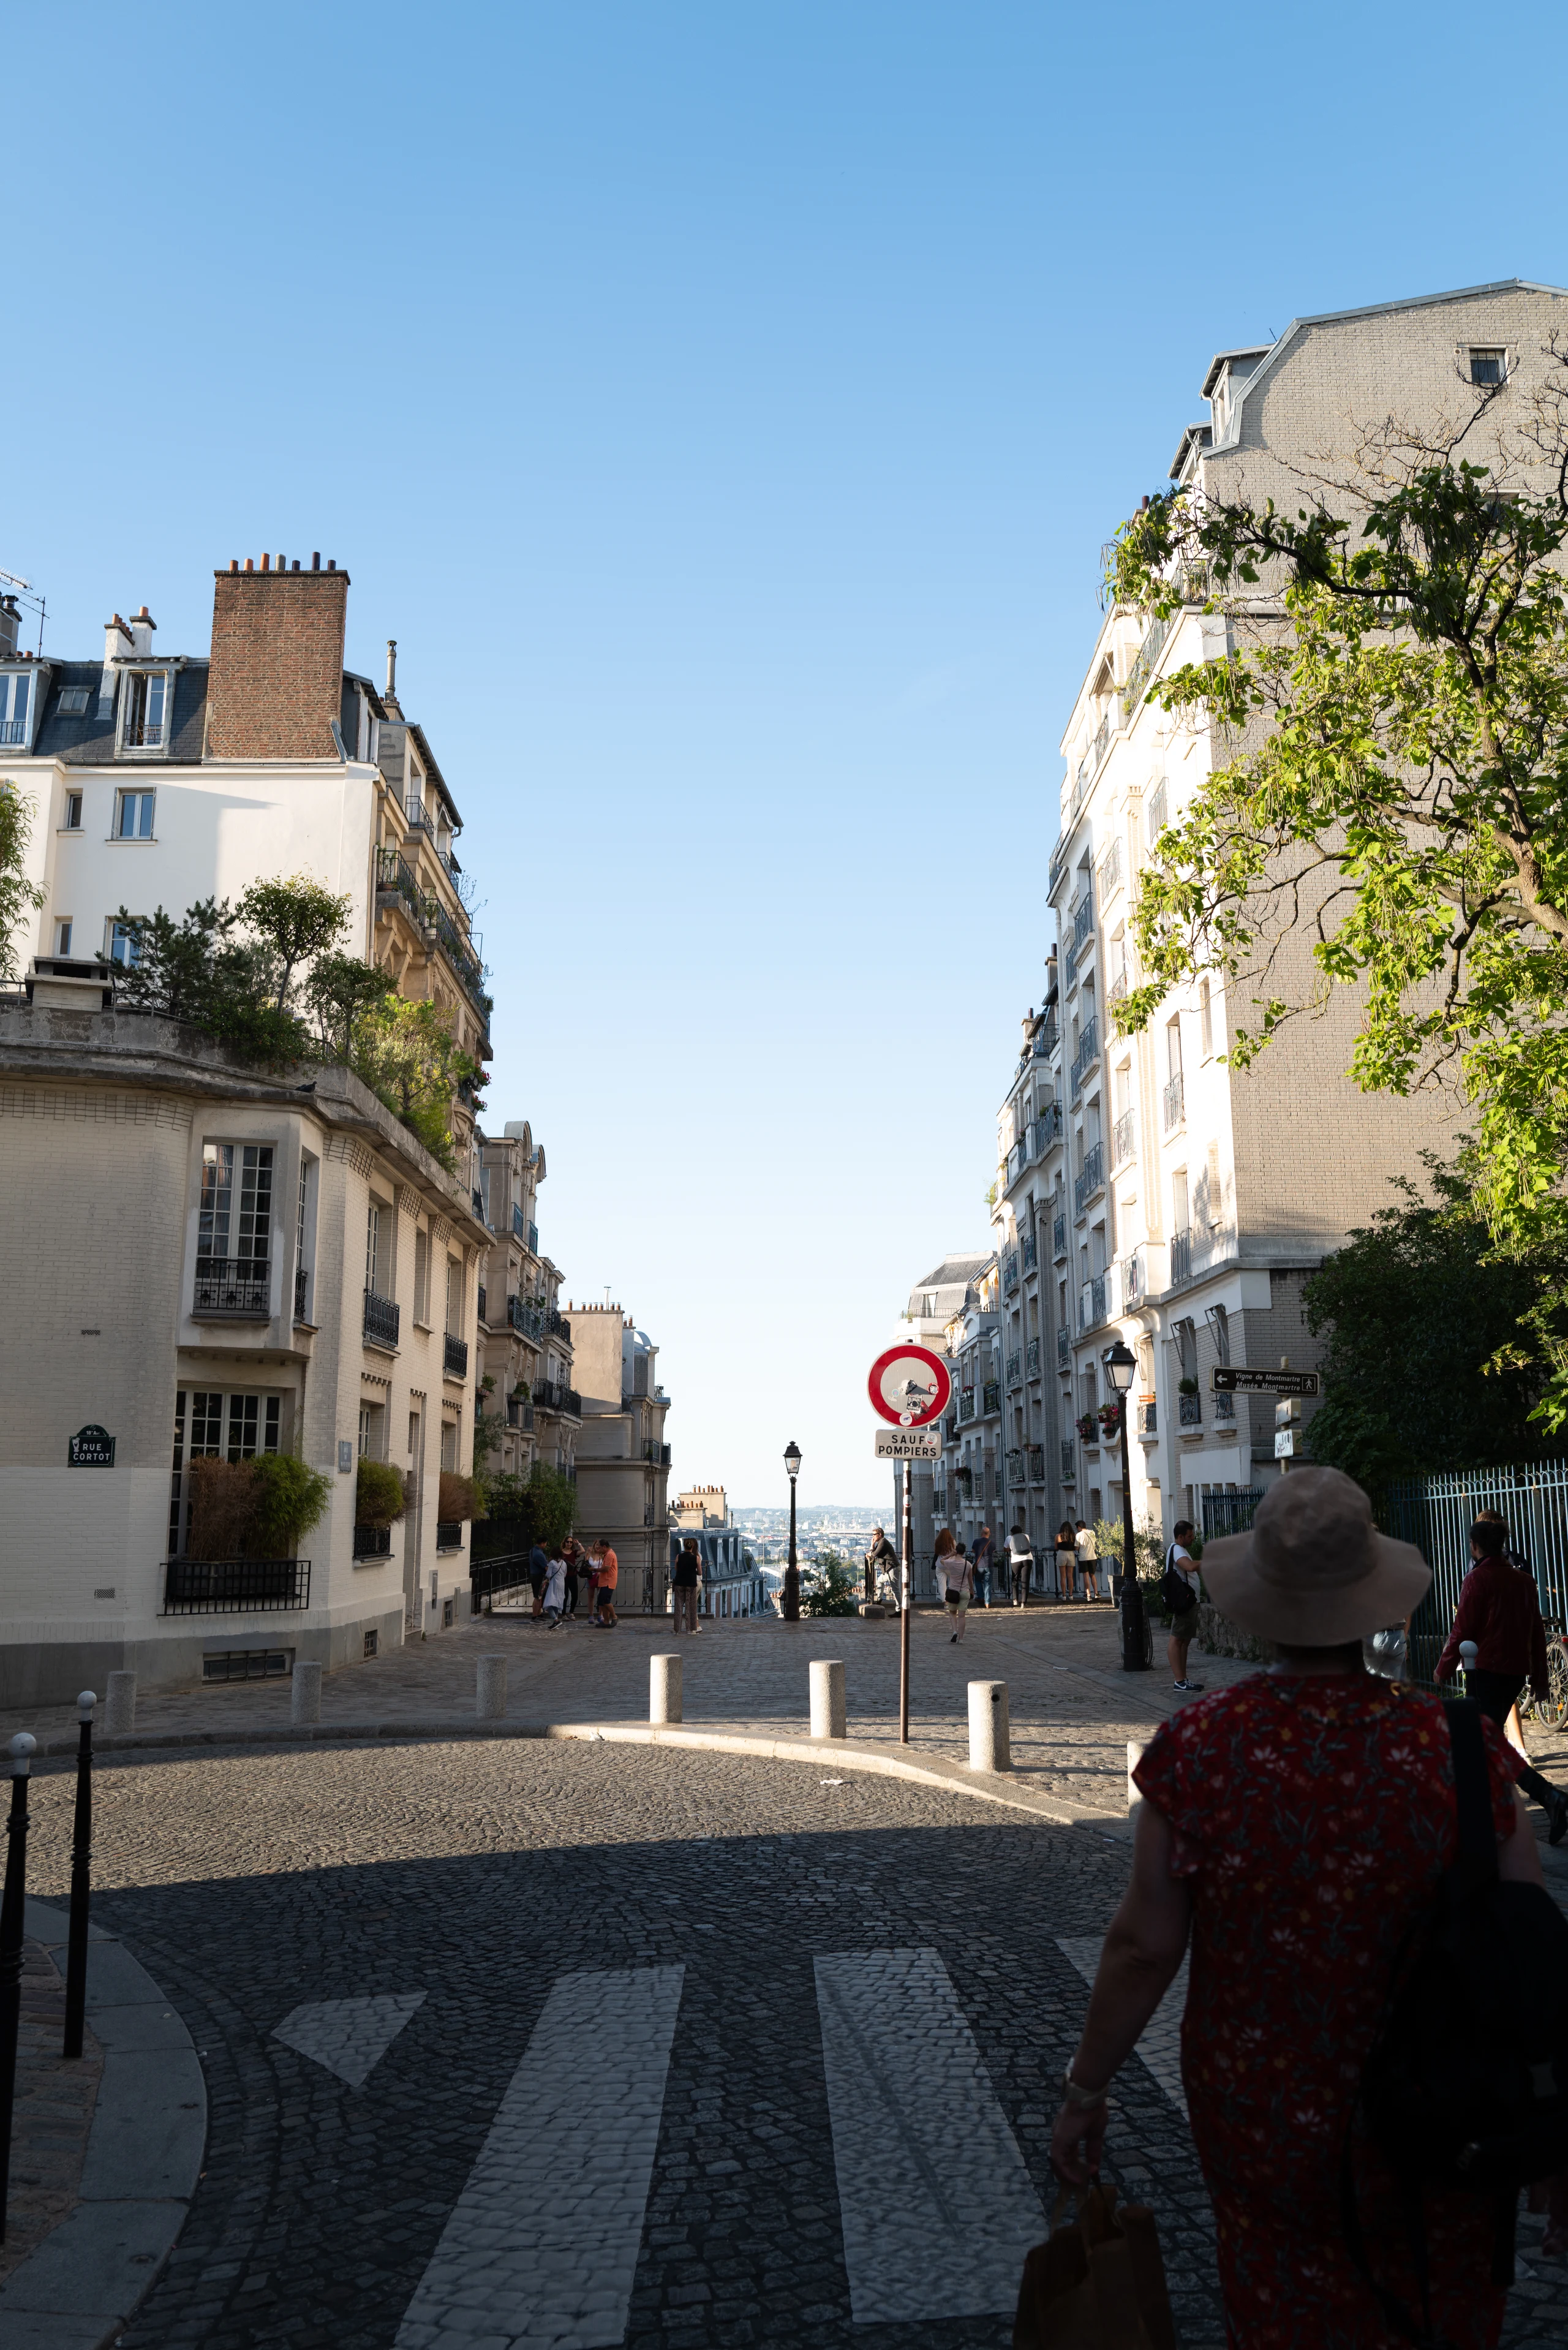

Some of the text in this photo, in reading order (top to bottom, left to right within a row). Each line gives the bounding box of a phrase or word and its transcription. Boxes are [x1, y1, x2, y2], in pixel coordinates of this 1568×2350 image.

[1235, 1372, 1253, 1381] Vigne
[1262, 1383, 1300, 1391] Montmartre
[891, 1434, 925, 1445] SAUF
[878, 1445, 937, 1457] POMPIERS
